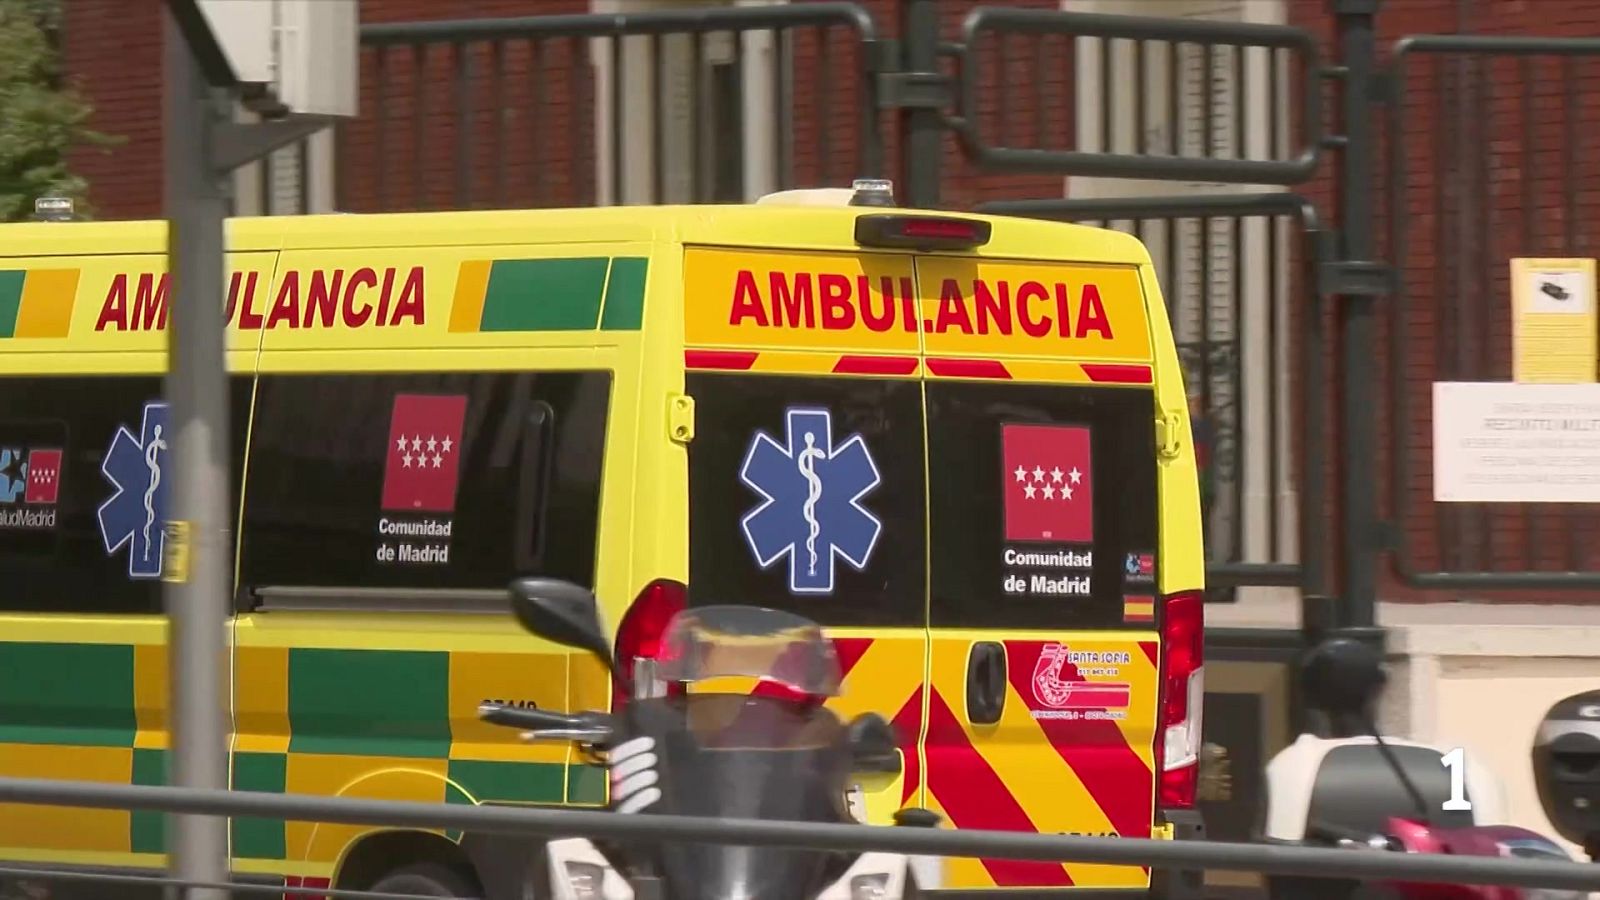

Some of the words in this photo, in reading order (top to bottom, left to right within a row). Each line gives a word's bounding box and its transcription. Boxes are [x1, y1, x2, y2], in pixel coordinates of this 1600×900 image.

[95, 266, 425, 332] AMLANCIA
[729, 269, 1113, 340] AMBULANCIA
[379, 518, 452, 536] Comunidad
[376, 543, 395, 561] de
[398, 544, 449, 563] Madrid
[1004, 549, 1093, 567] Comunidad
[1004, 575, 1027, 592] de
[1030, 575, 1091, 594] Madrid
